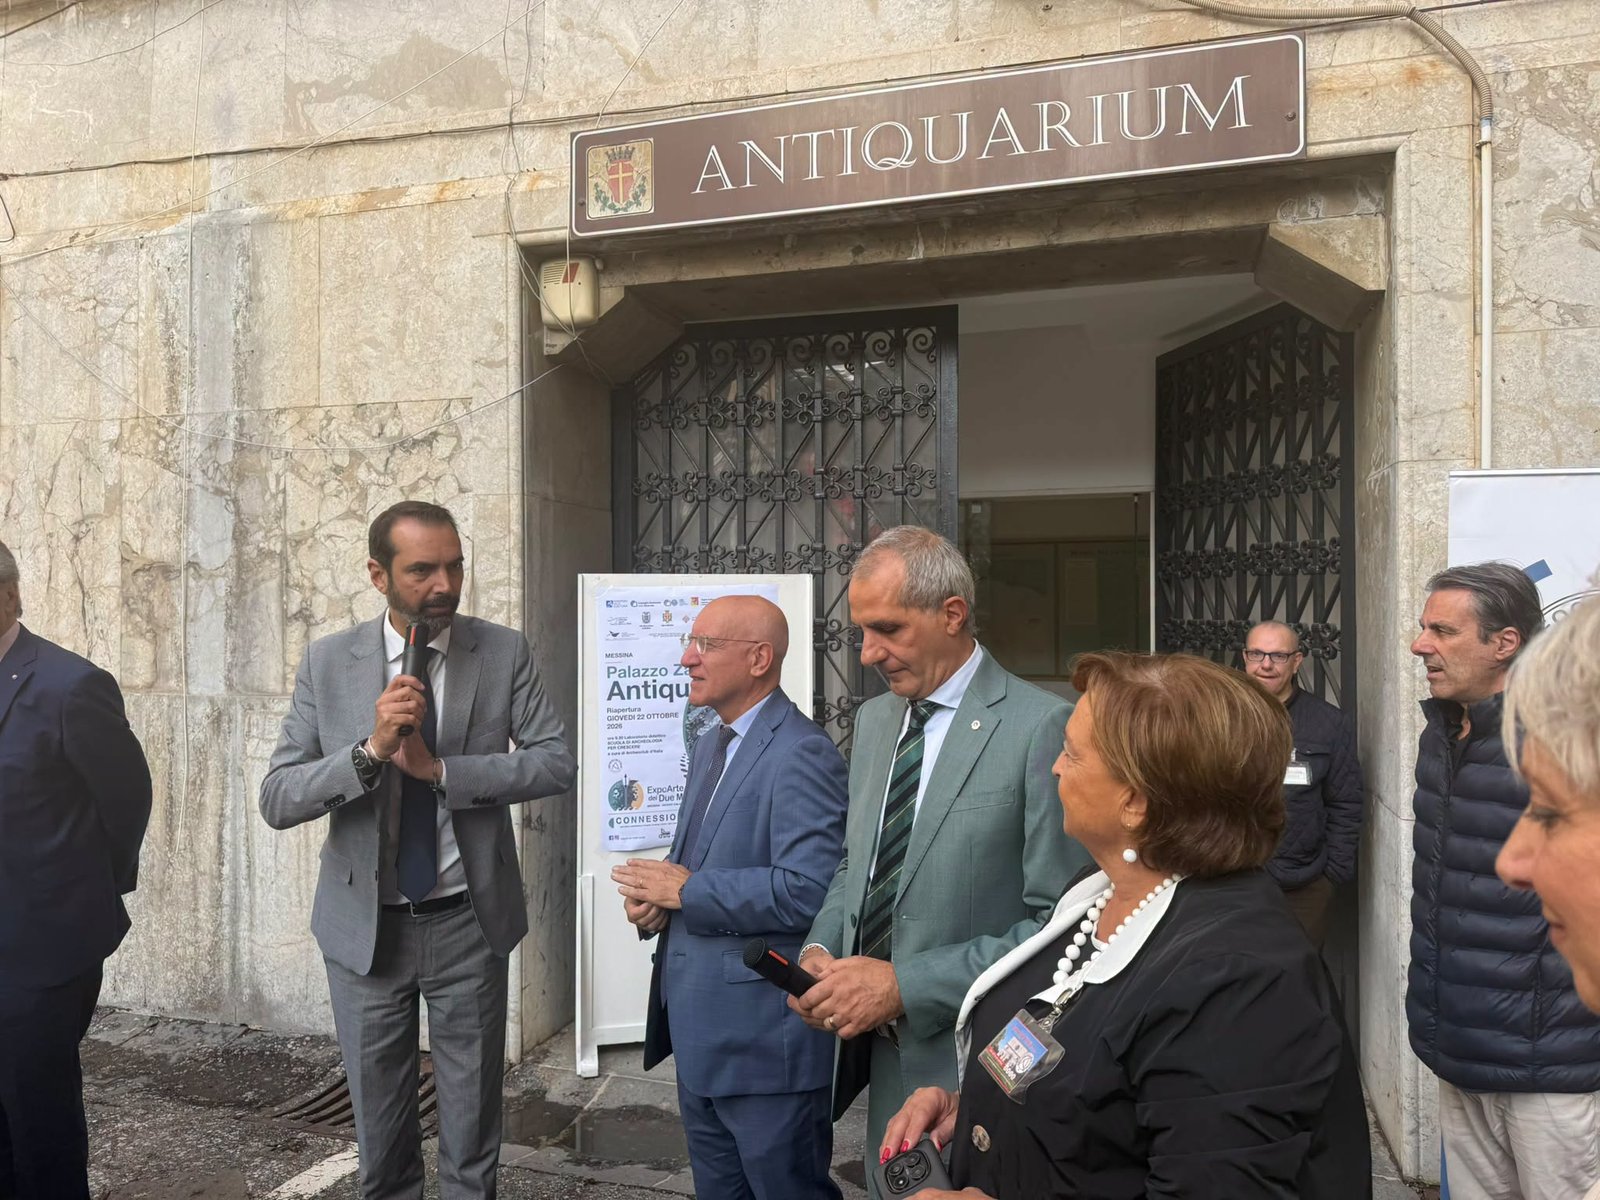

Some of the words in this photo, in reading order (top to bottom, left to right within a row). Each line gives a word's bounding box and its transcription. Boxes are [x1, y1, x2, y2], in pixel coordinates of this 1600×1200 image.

[690, 74, 1254, 195] ANTIQUARIUM
[607, 665, 668, 679] Palazzo
[606, 679, 689, 702] Antiqu
[659, 794, 675, 802] Due
[616, 814, 676, 824] CONNESSIO
